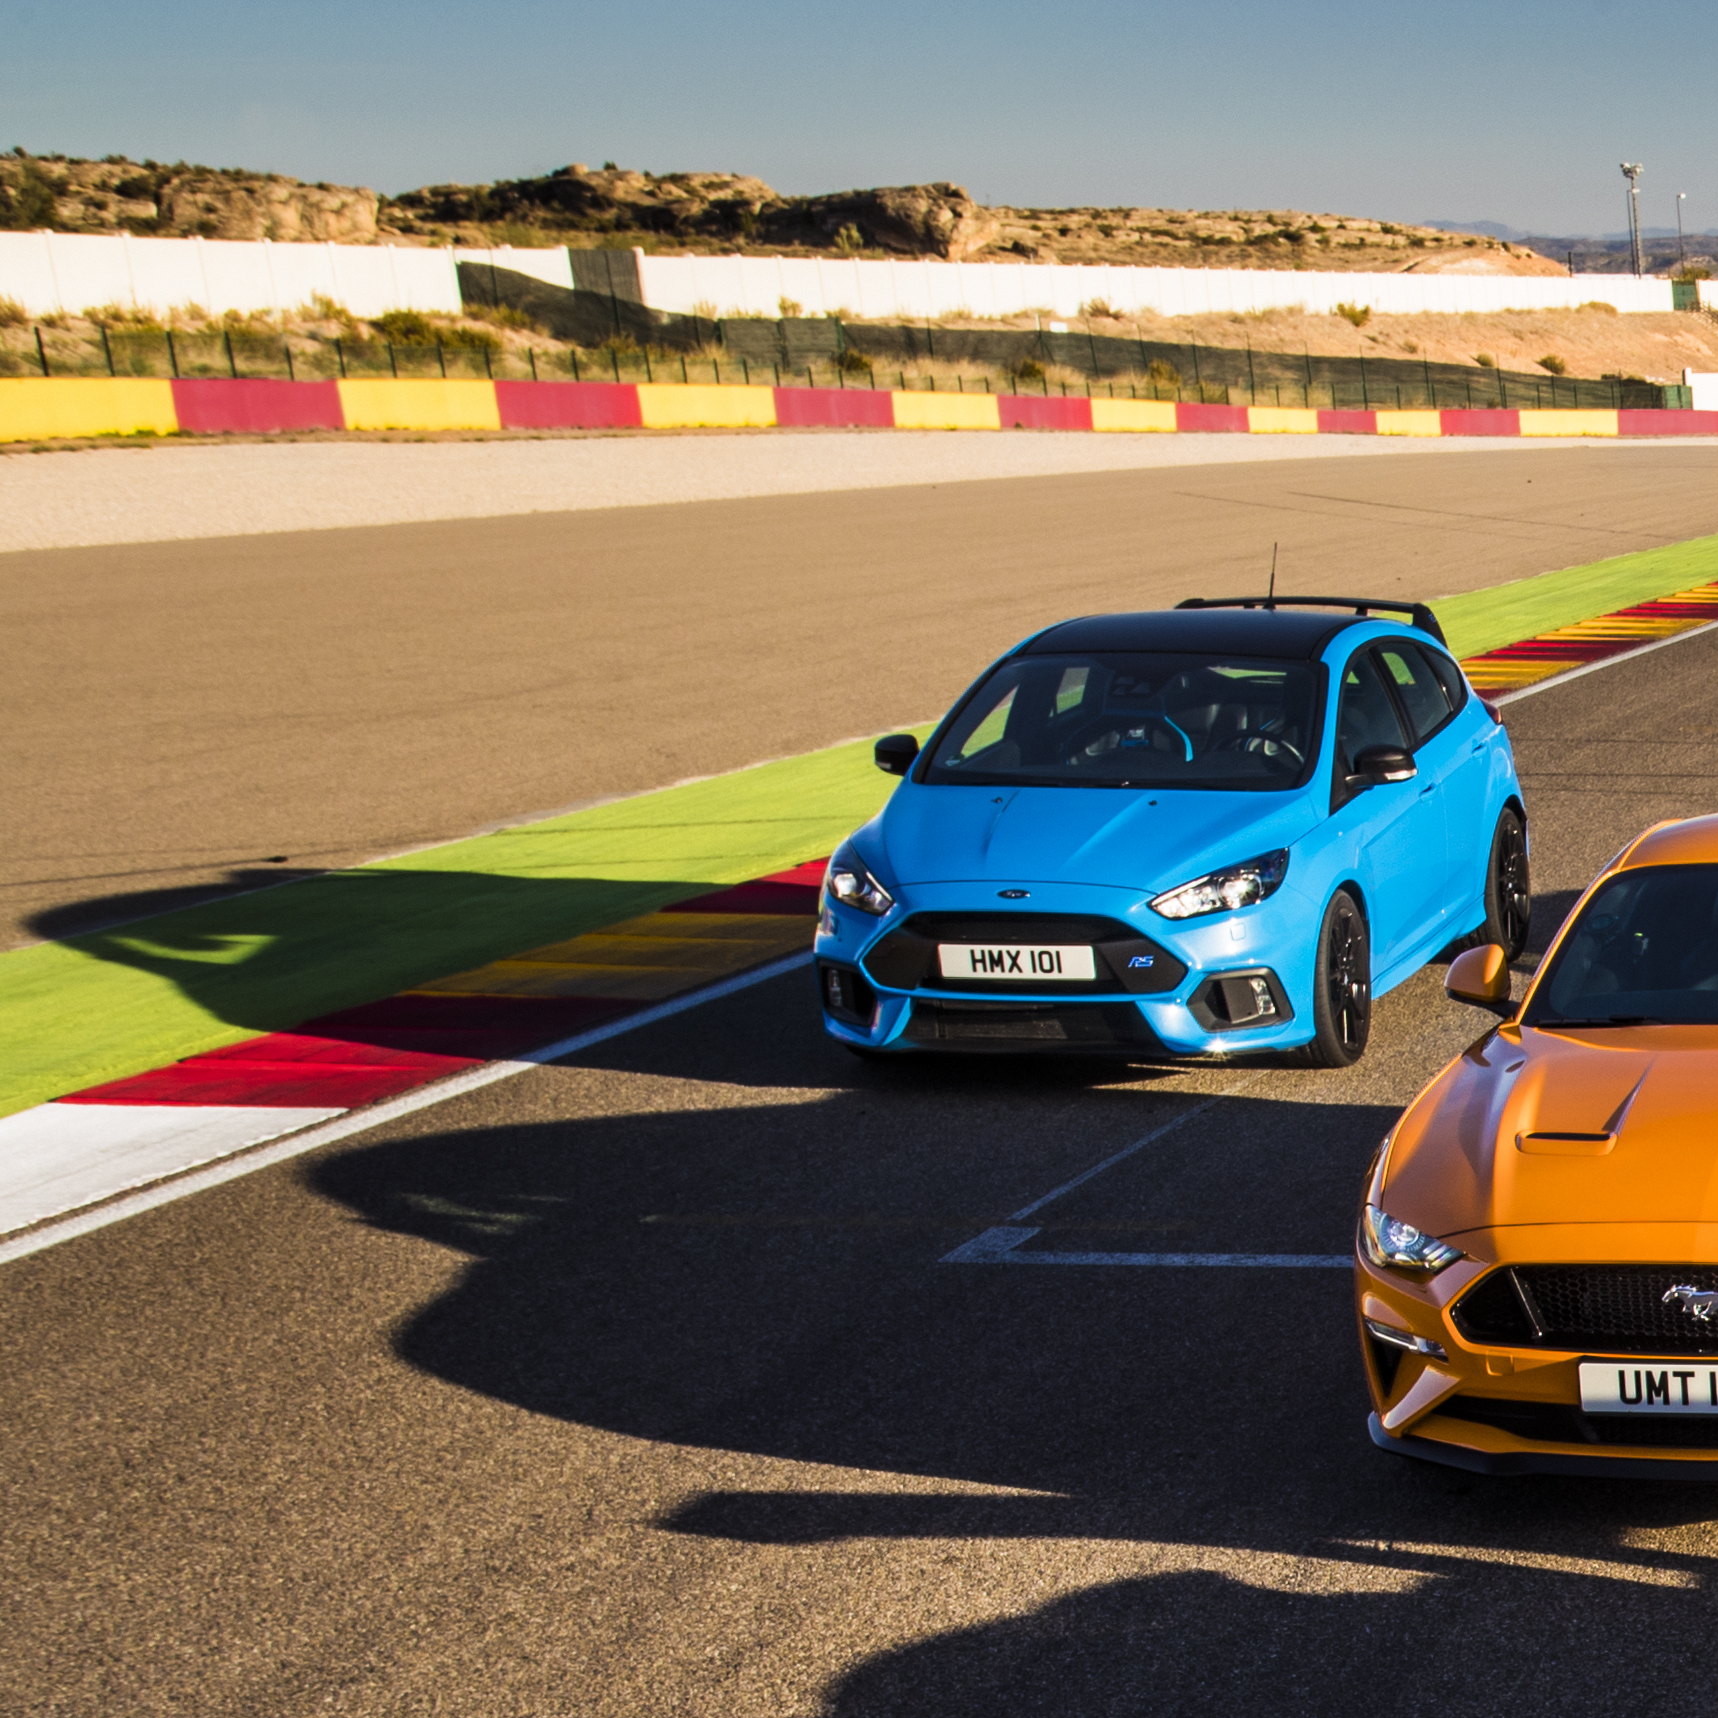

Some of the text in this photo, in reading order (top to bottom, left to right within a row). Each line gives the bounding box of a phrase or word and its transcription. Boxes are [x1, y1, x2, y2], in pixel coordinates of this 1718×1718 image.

[969, 949, 1062, 974] HMX 101
[1128, 955, 1155, 968] RS
[1618, 1370, 1696, 1406] UMT
